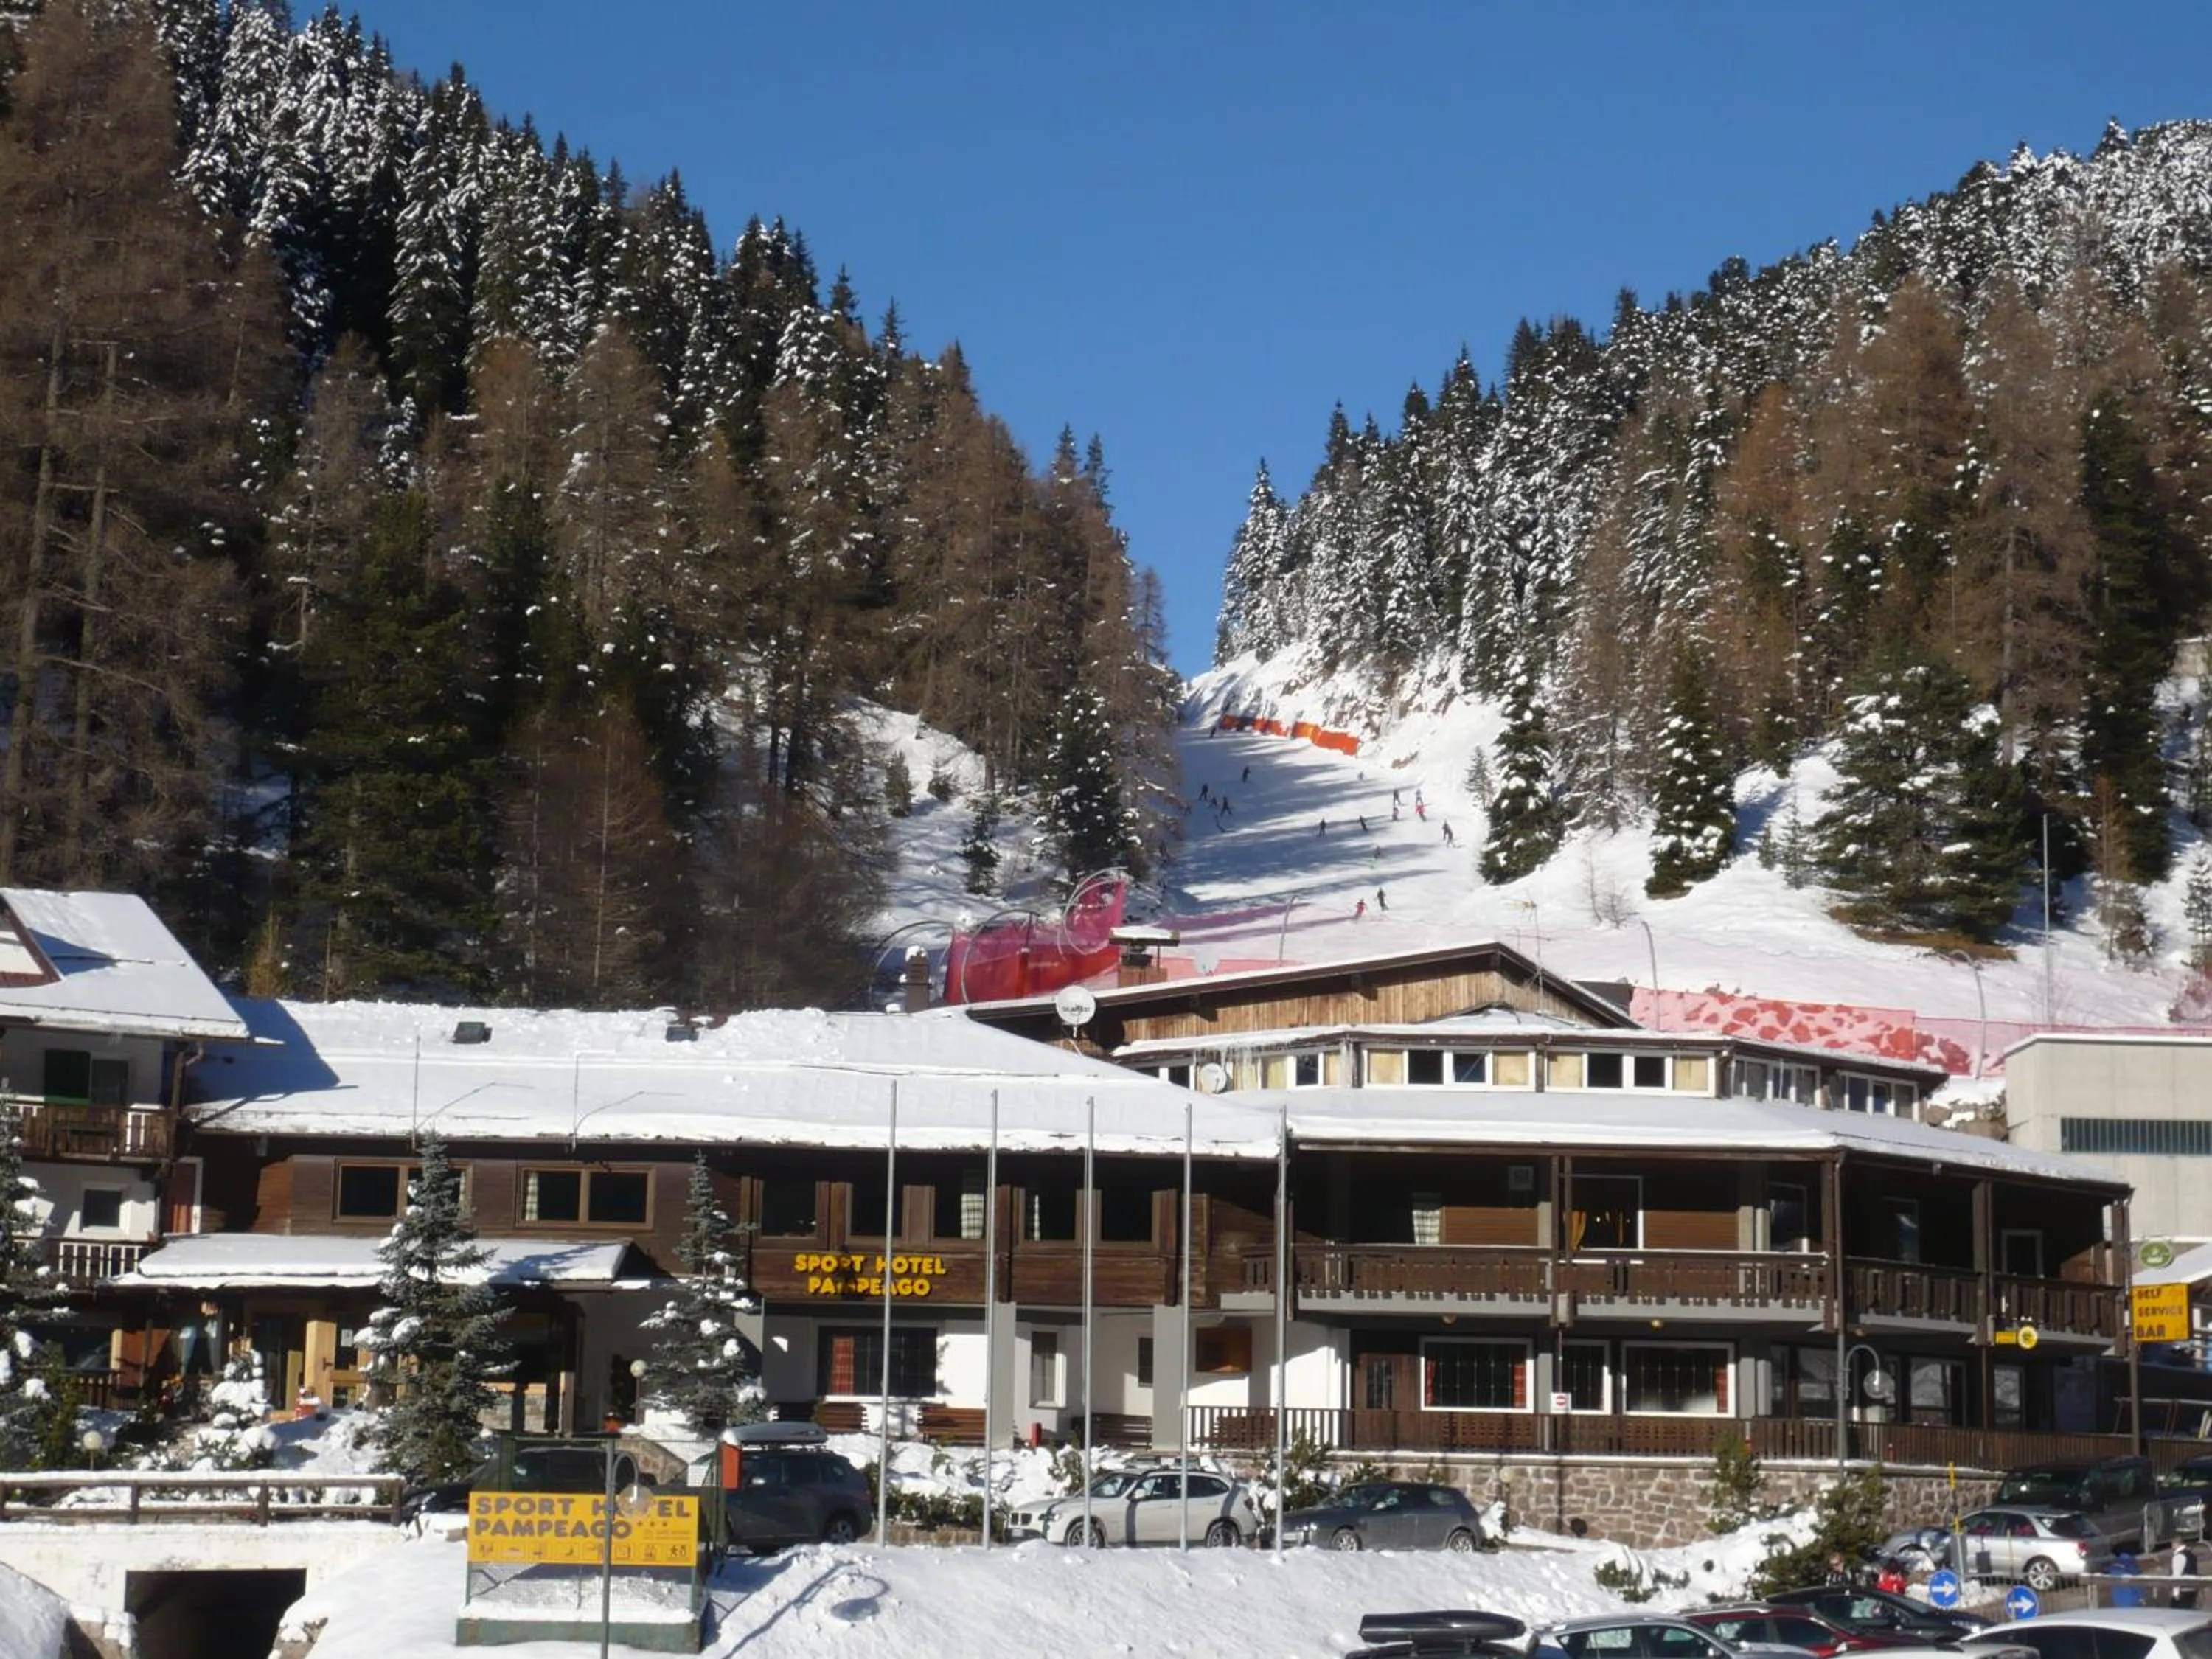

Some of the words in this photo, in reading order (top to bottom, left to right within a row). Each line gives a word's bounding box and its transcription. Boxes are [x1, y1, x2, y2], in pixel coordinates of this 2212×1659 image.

[807, 1276, 930, 1295] PAPEAGO
[2135, 1324, 2166, 1338] BAR
[476, 1496, 576, 1516] SPORT
[474, 1518, 632, 1540] PAMPEAGO
